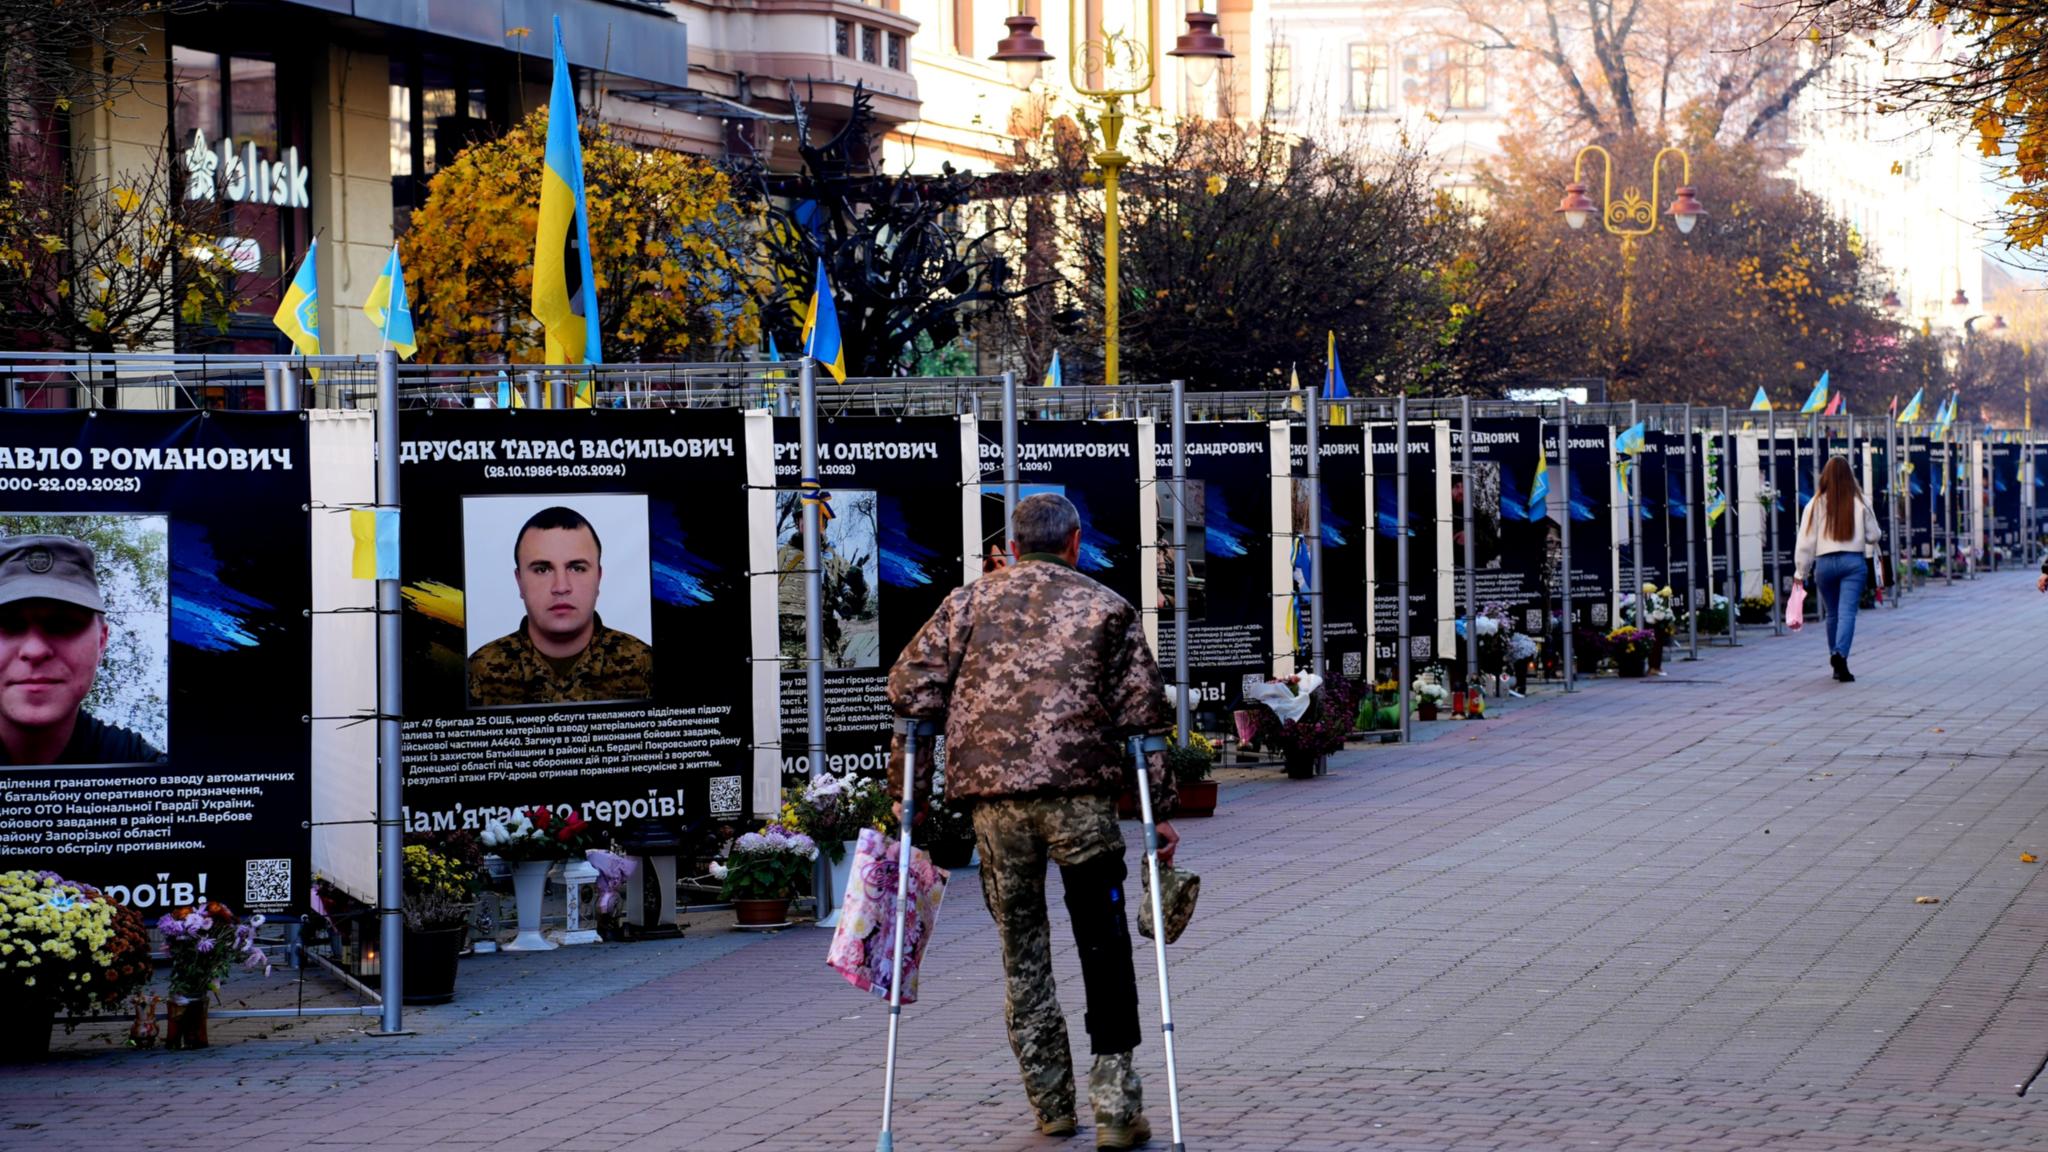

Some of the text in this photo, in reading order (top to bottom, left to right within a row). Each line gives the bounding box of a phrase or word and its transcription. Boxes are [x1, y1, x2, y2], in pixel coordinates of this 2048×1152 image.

[224, 137, 309, 208] blisk
[90, 447, 293, 471] РОМАНОВИЧ
[399, 438, 735, 464] ДРУСЯК ТАРАС ВАСИЛЬОВИЧ
[774, 441, 938, 460] РТМ ОЛЕГОВИЧ
[484, 463, 626, 479] (28.10.1986-19.03.2024)
[824, 685, 864, 695] иконуючи
[846, 675, 889, 686] гірсько-шт
[402, 720, 419, 730] дат
[435, 718, 475, 730] бригада
[476, 717, 487, 725] 25
[516, 714, 546, 724] номер
[548, 711, 585, 724] обслуги
[587, 709, 646, 720] такелажного
[647, 707, 696, 717] відділення
[698, 704, 732, 716] підвозу
[874, 702, 895, 713] Нагр
[435, 731, 445, 739] та
[447, 728, 504, 738] мастильних
[505, 724, 555, 736] матеріалів
[556, 722, 588, 733] взводу
[590, 720, 656, 731] матеріального
[657, 716, 720, 727] забезпечення
[430, 752, 438, 761] із
[440, 752, 484, 761] захистом
[486, 748, 546, 760] Батьківщини
[556, 744, 587, 756] районі
[606, 741, 643, 753] Бердичі
[645, 739, 708, 751] Покровського
[709, 736, 741, 748] району
[450, 740, 489, 749] частини
[524, 736, 562, 746] Загинув
[571, 733, 591, 743] ході
[592, 732, 642, 742] виконання
[643, 728, 681, 739] бойових
[683, 728, 721, 738] завдань,
[409, 763, 460, 775] Донецької
[461, 760, 497, 771] області
[498, 759, 513, 770] під
[515, 758, 531, 768] час
[532, 756, 584, 768] оборонних
[585, 754, 600, 765] дій
[602, 755, 619, 764] при
[621, 751, 663, 762] зіткненні
[672, 750, 712, 761] ворогом.
[54, 776, 157, 789] гранатометного
[160, 775, 204, 786] взводу
[207, 772, 295, 783] автоматичних
[407, 774, 457, 787] результаті
[459, 773, 486, 783] атаки
[539, 769, 579, 779] отримав
[580, 766, 630, 777] поранення
[632, 763, 677, 773] несумісне
[686, 760, 722, 770] життям.
[5, 786, 264, 803] батальйону оперативного призначення,
[0, 798, 255, 817] ного ОТО Національної Гвардії України.
[581, 789, 684, 827] героїв!
[56, 817, 117, 828] завдання
[120, 817, 128, 825] в
[131, 813, 174, 827] районі
[45, 829, 121, 842] Запорізької
[124, 826, 171, 839] області
[57, 842, 114, 855] обстрілу
[116, 840, 206, 854] противником.
[104, 873, 207, 909] роїв!
